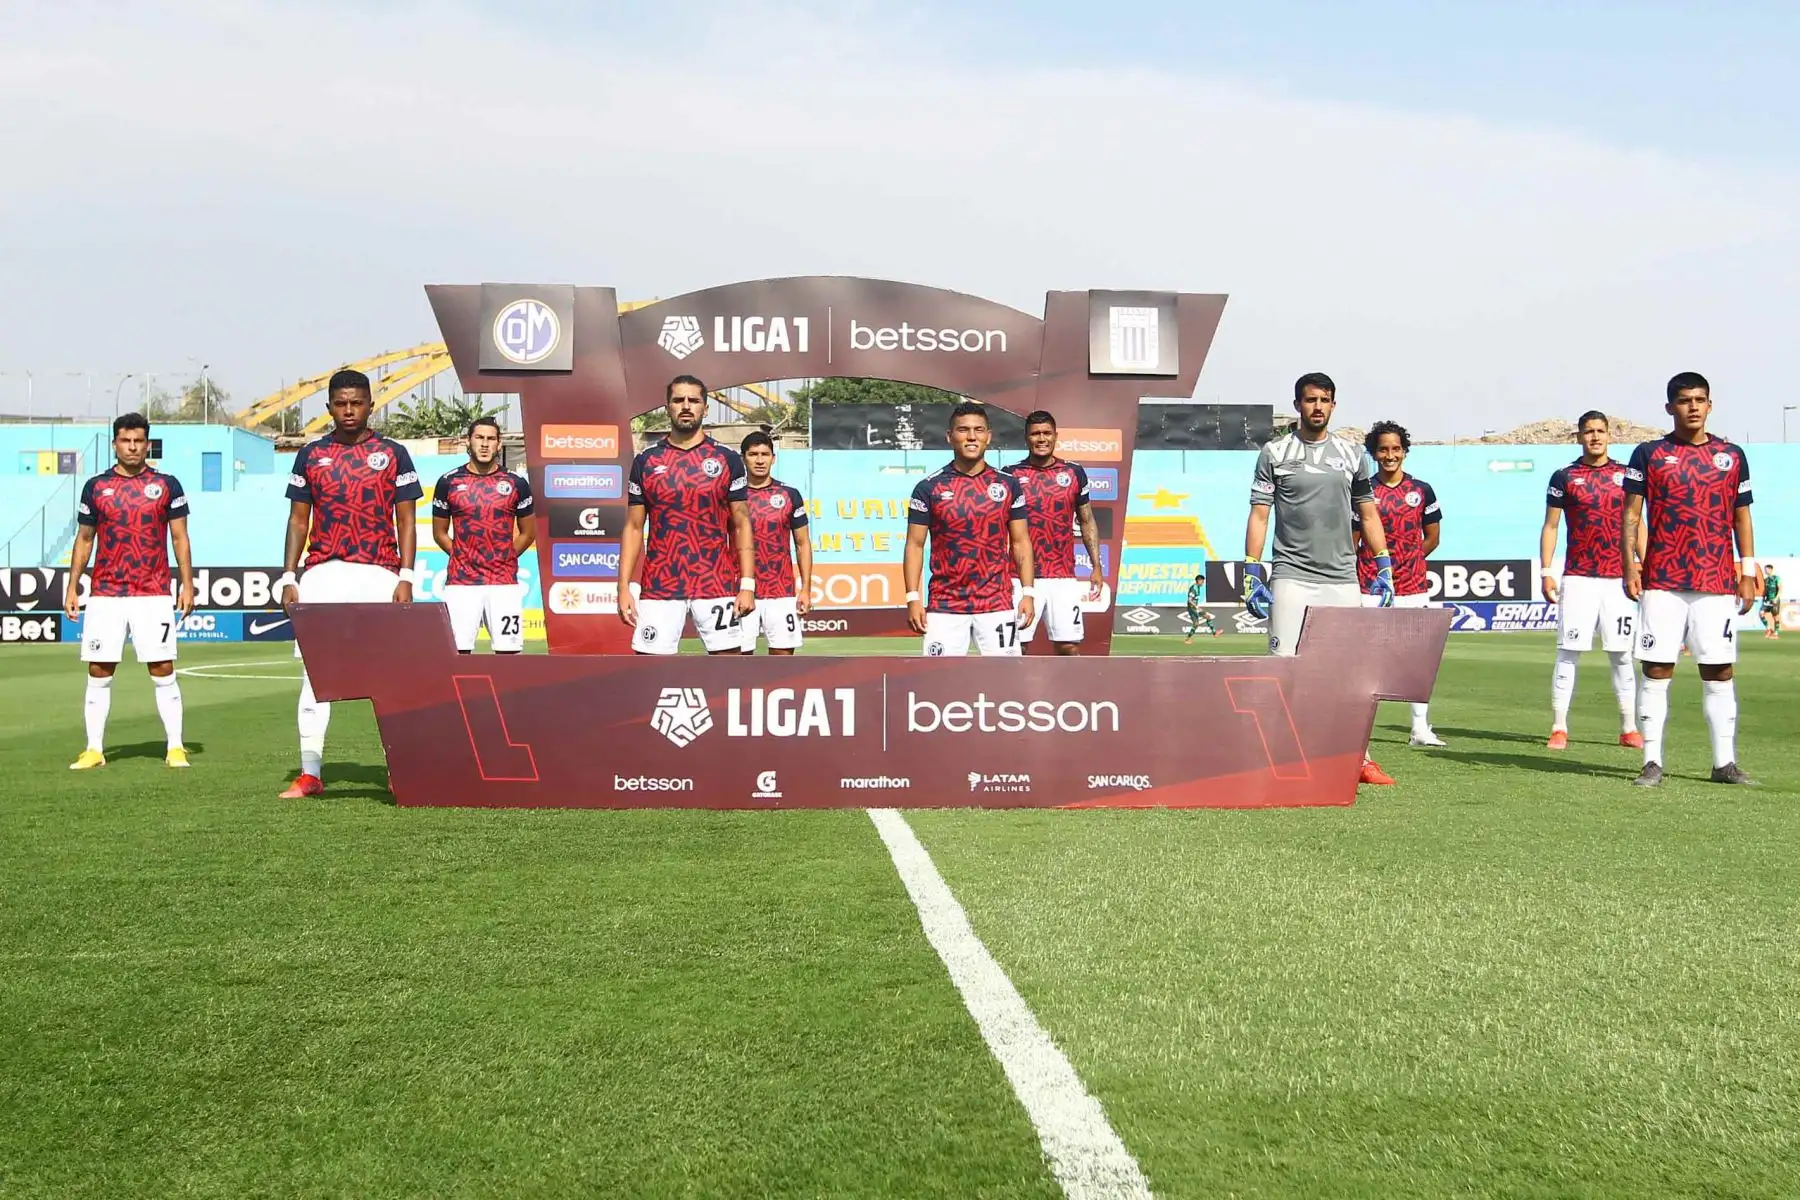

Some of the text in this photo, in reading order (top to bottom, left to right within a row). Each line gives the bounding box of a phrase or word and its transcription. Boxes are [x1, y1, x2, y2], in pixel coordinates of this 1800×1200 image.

[850, 320, 1007, 352] betsson
[545, 434, 615, 449] betsson
[553, 475, 614, 487] marathon
[559, 554, 580, 567] SAN
[1119, 581, 1189, 595] DEPORTIVA
[711, 601, 740, 631] 22
[785, 613, 796, 632] 9
[1072, 605, 1081, 625] 2
[2, 616, 56, 641] Bet
[160, 622, 170, 643] 7
[501, 616, 520, 635] 23
[800, 619, 848, 631] tsson
[995, 621, 1016, 648] 17
[1616, 616, 1632, 636] 15
[1723, 618, 1733, 642] 4
[907, 691, 1119, 733] betsson
[614, 775, 694, 791] betsson
[840, 775, 910, 788] marathon
[983, 774, 1030, 783] LATAM
[1088, 775, 1108, 788] SAN
